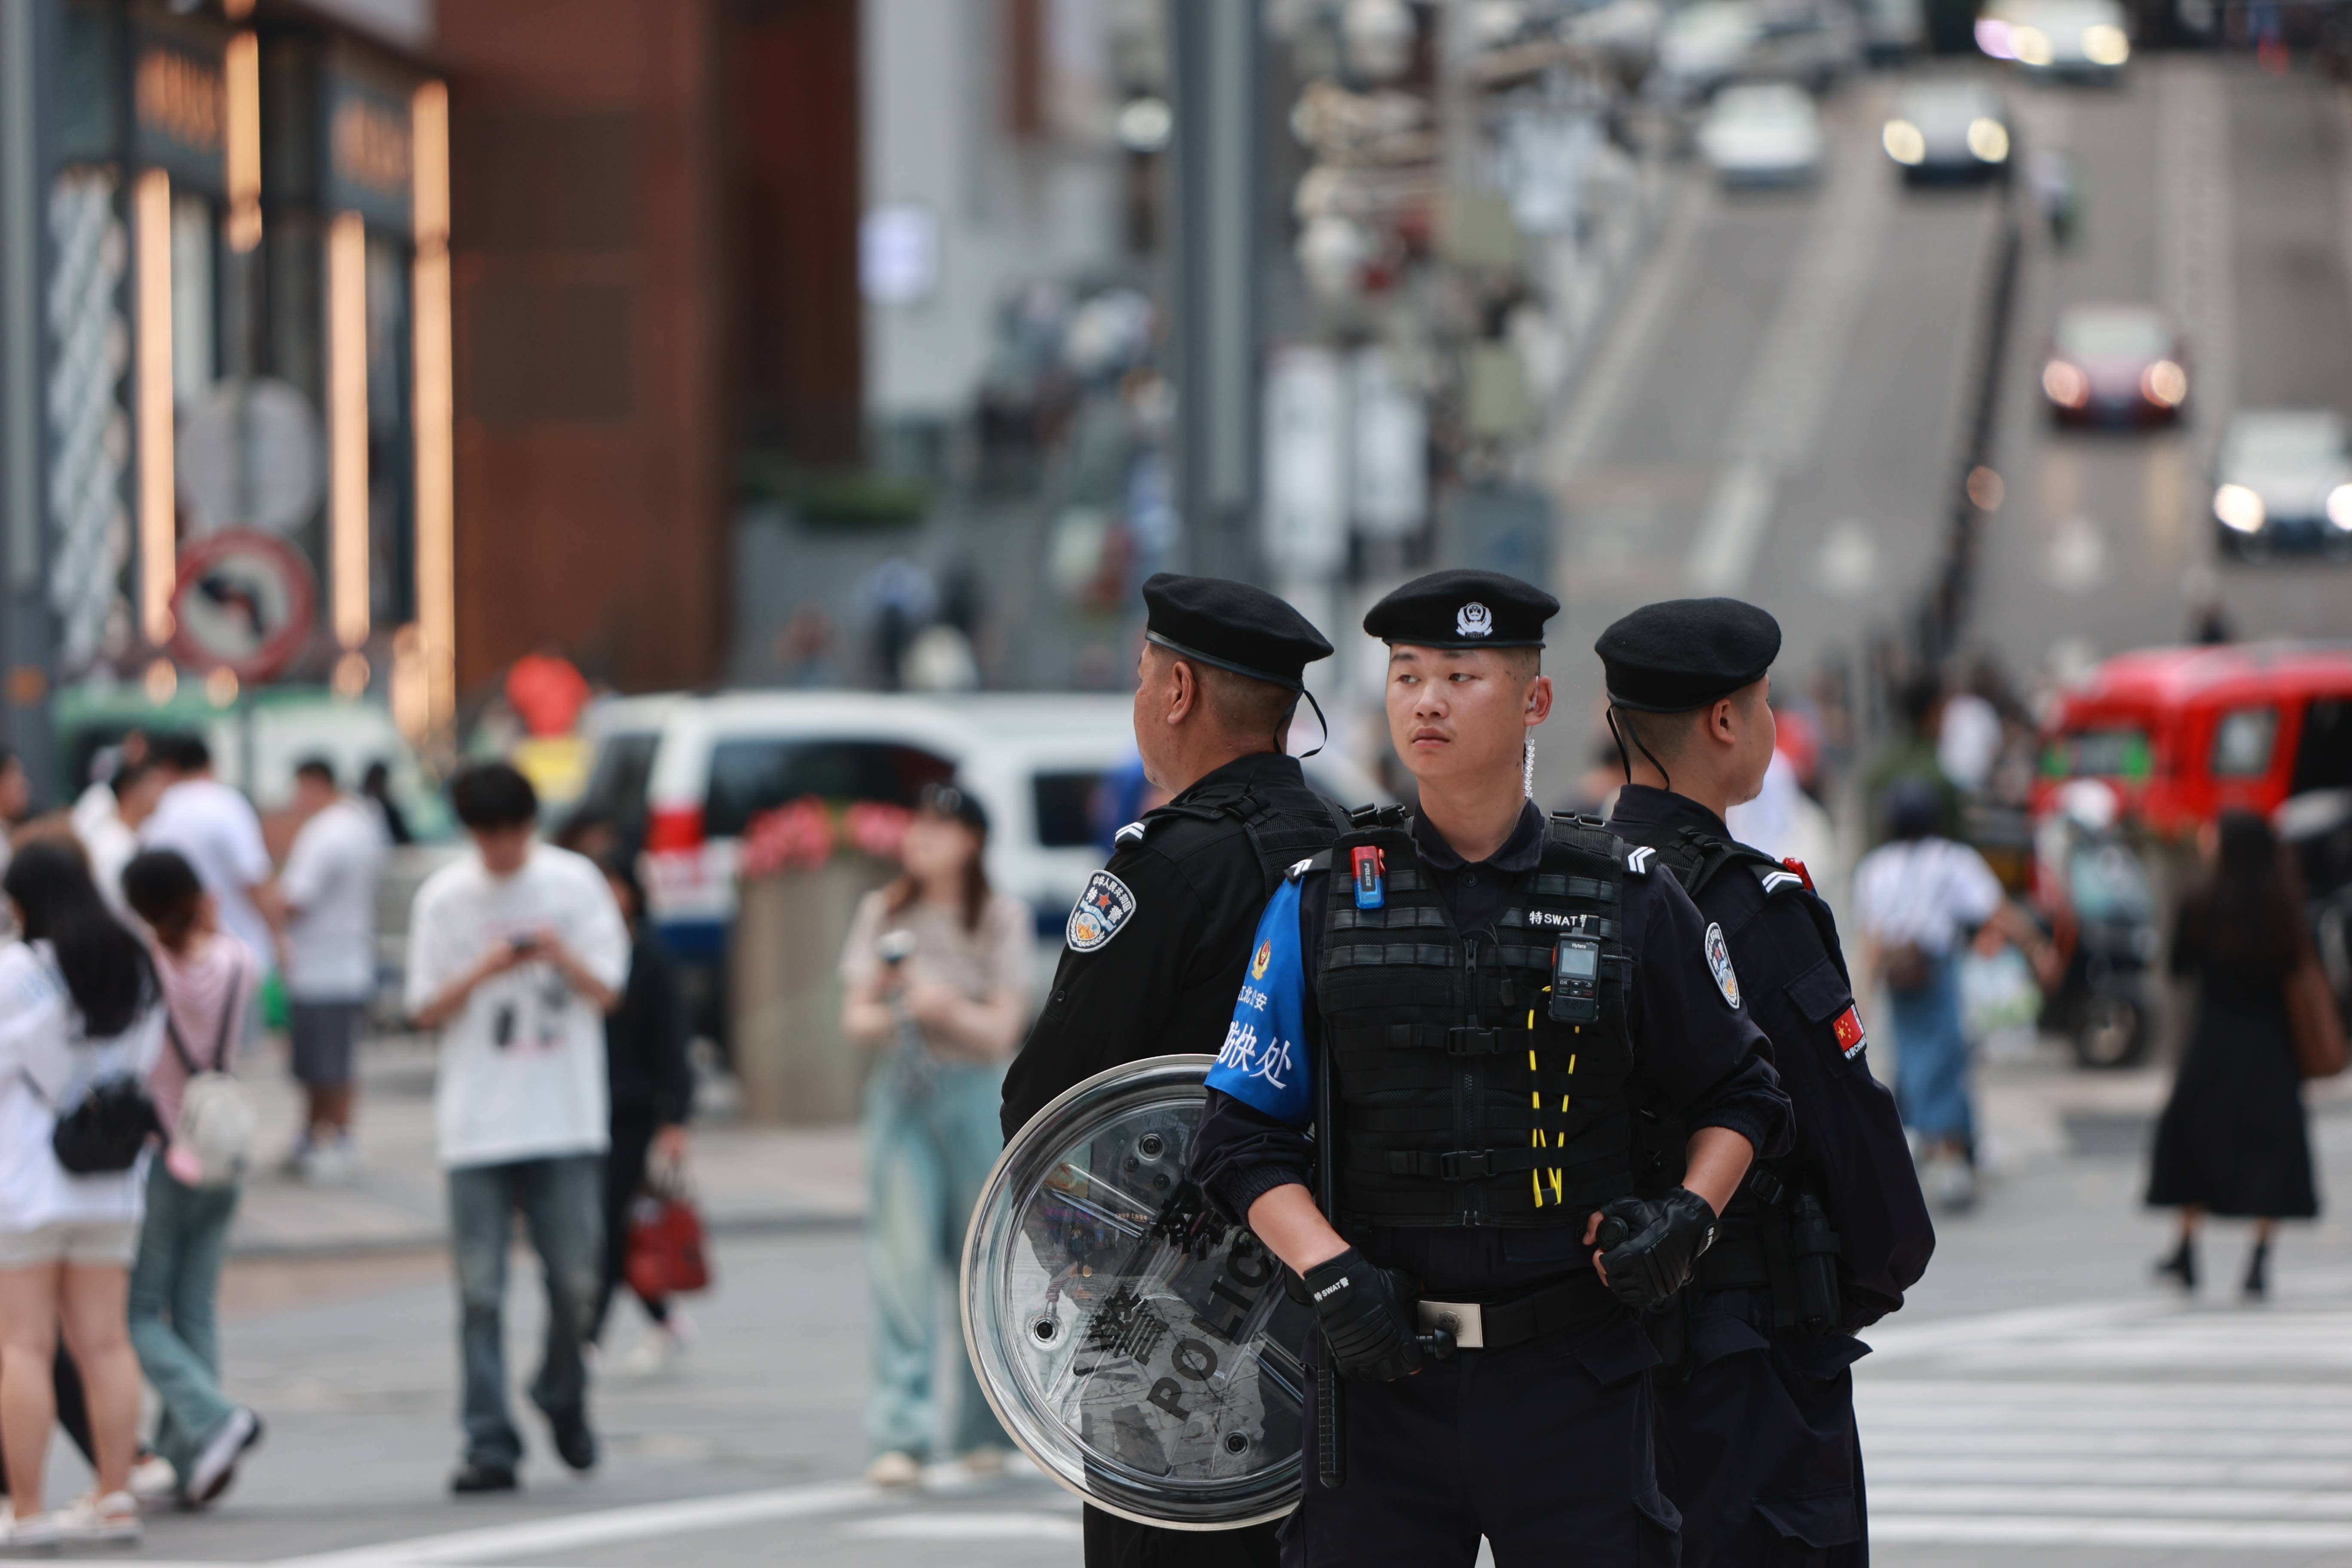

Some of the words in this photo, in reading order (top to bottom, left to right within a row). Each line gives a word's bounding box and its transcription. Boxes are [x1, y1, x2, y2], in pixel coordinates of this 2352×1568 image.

[1093, 875, 1132, 913] 中华人民共和国
[1145, 1232, 1273, 1422] POLIC
